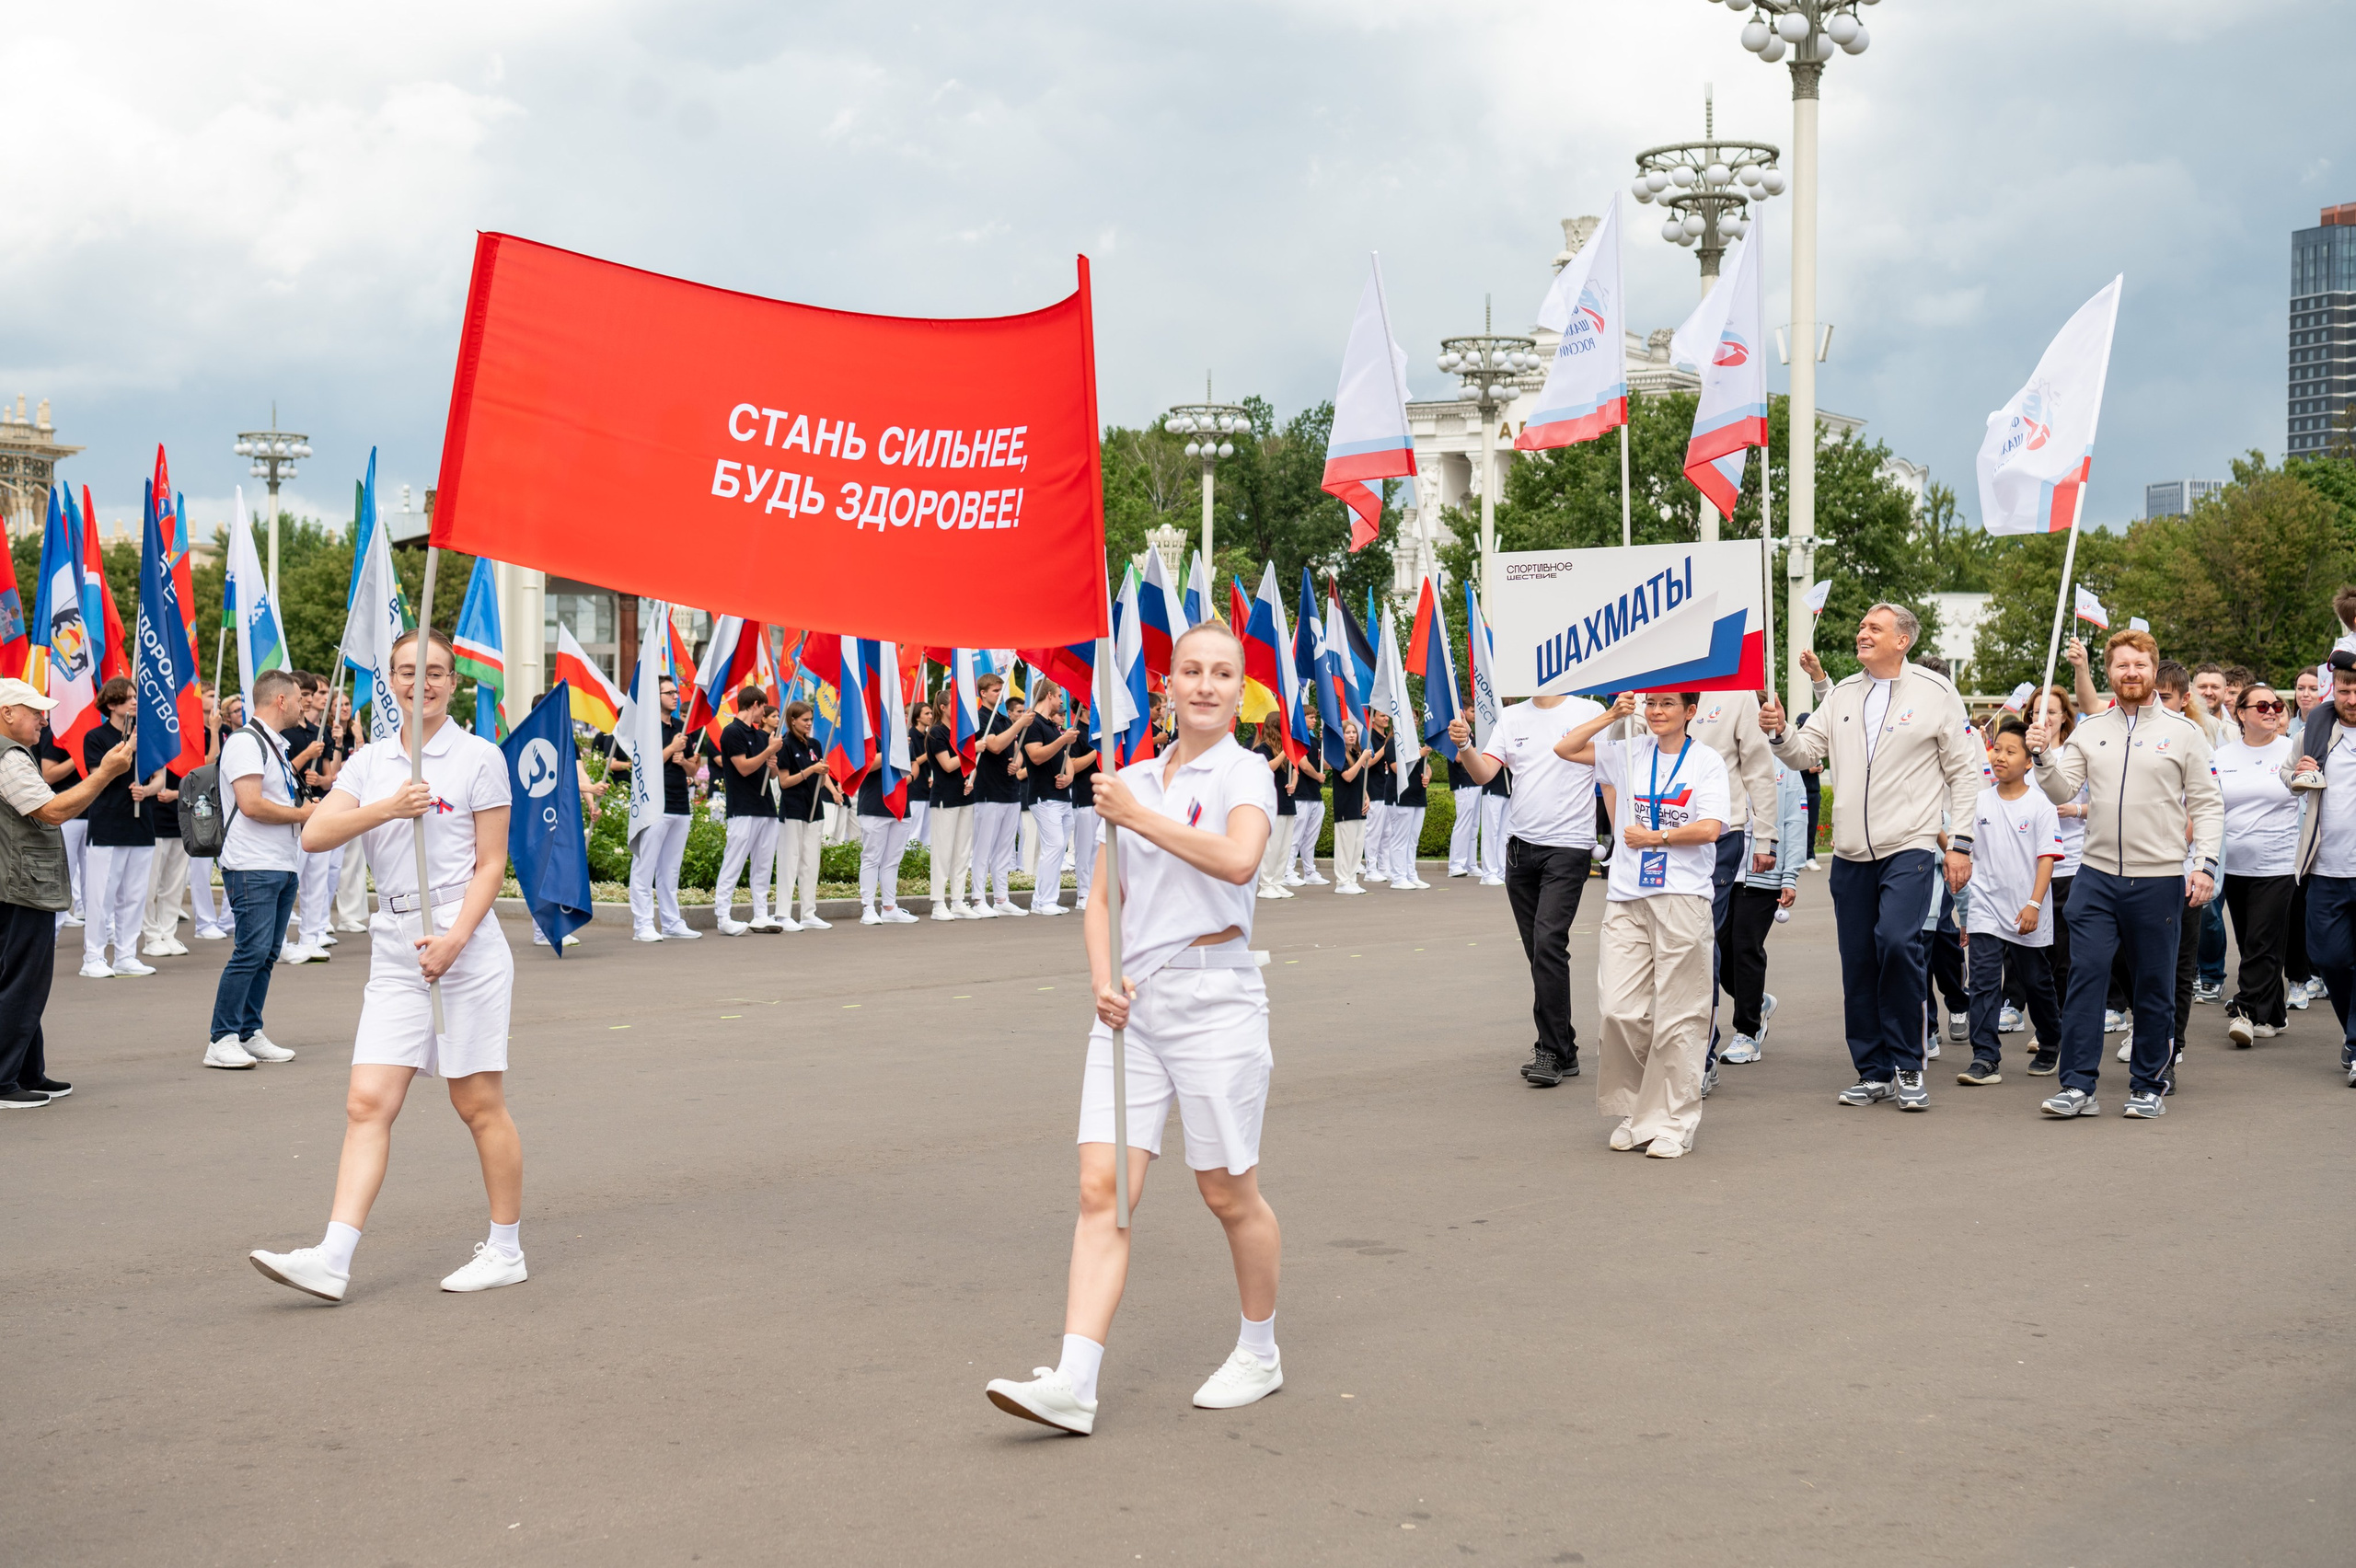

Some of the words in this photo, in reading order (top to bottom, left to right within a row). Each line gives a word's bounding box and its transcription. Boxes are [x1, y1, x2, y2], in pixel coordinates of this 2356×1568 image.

[728, 403, 867, 460] СТАНЬ
[878, 425, 1028, 473] СИЛЬНЕЕ,
[711, 458, 826, 519] БУДЬ
[836, 482, 1024, 532] ЗДОРОВЕЕ!
[1507, 572, 1557, 581] ШЕСТВИЕ
[1536, 555, 1692, 687] ШАХМАТЫ
